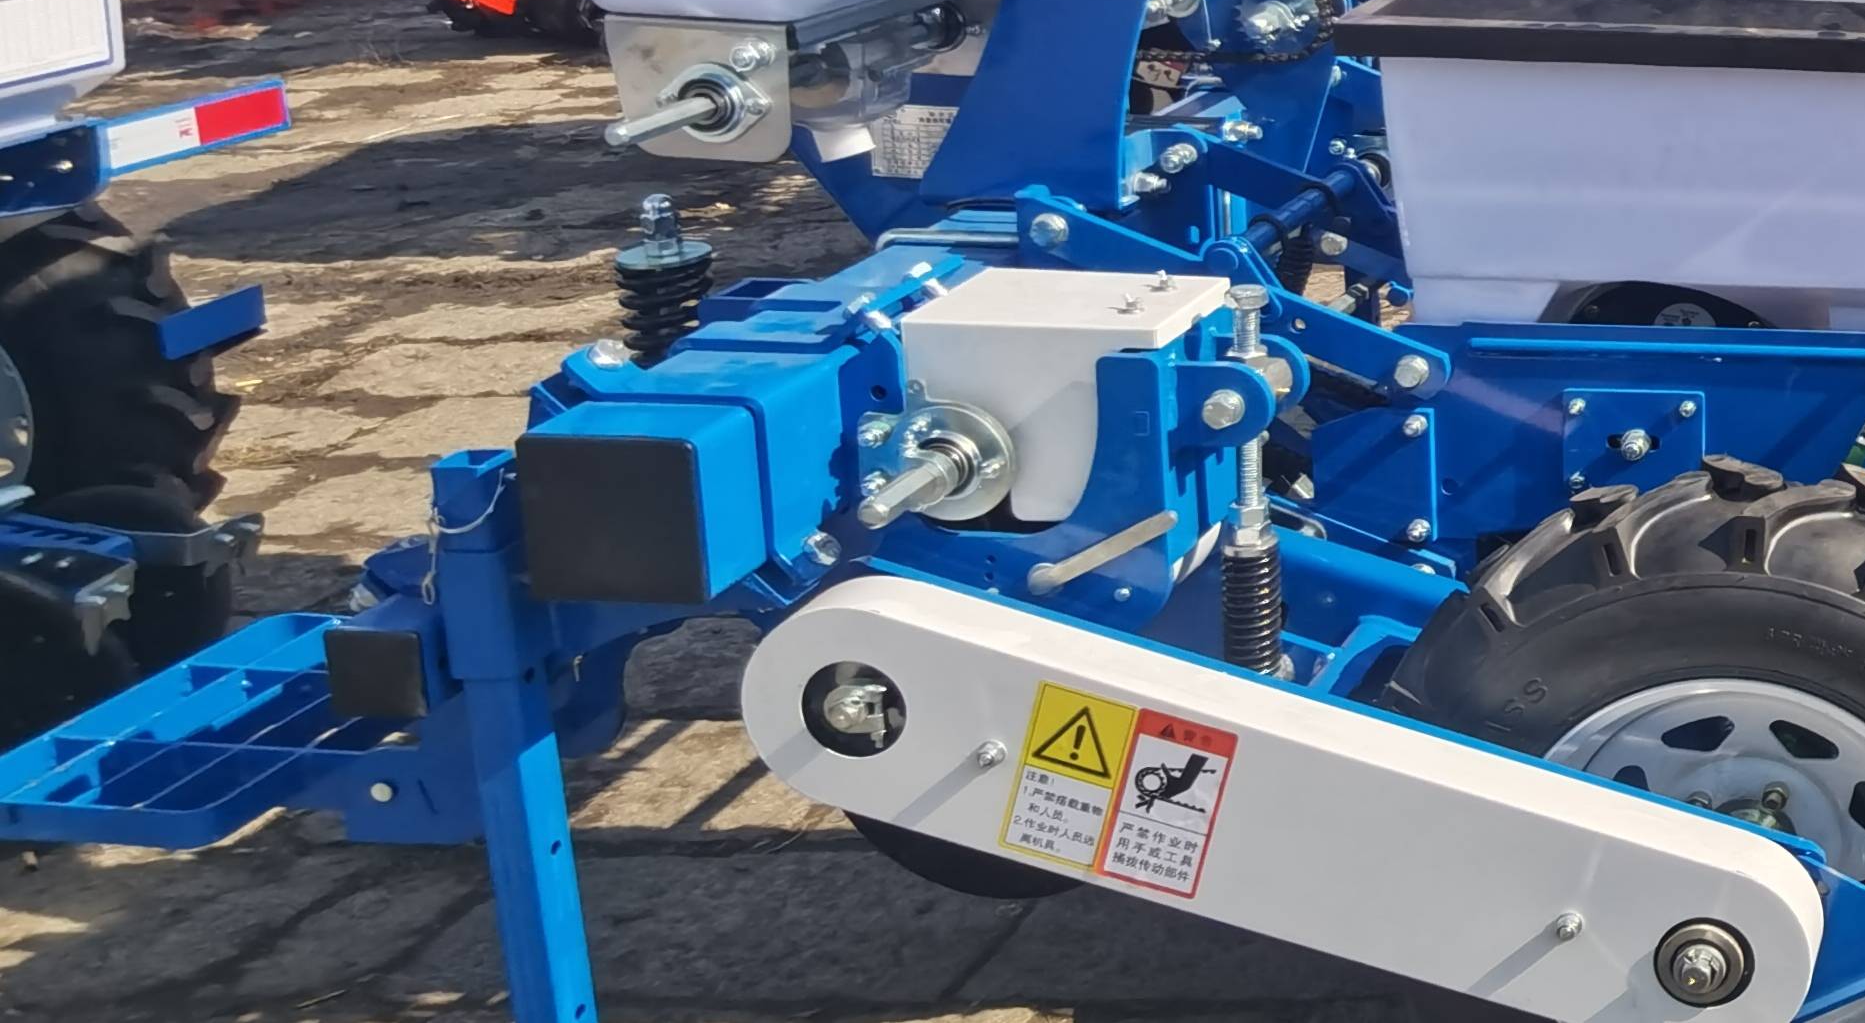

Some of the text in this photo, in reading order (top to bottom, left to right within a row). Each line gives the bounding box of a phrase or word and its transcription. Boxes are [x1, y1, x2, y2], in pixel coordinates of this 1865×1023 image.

[1115, 837, 1194, 868] 用手或工具
[1119, 822, 1199, 854] 严禁作业时
